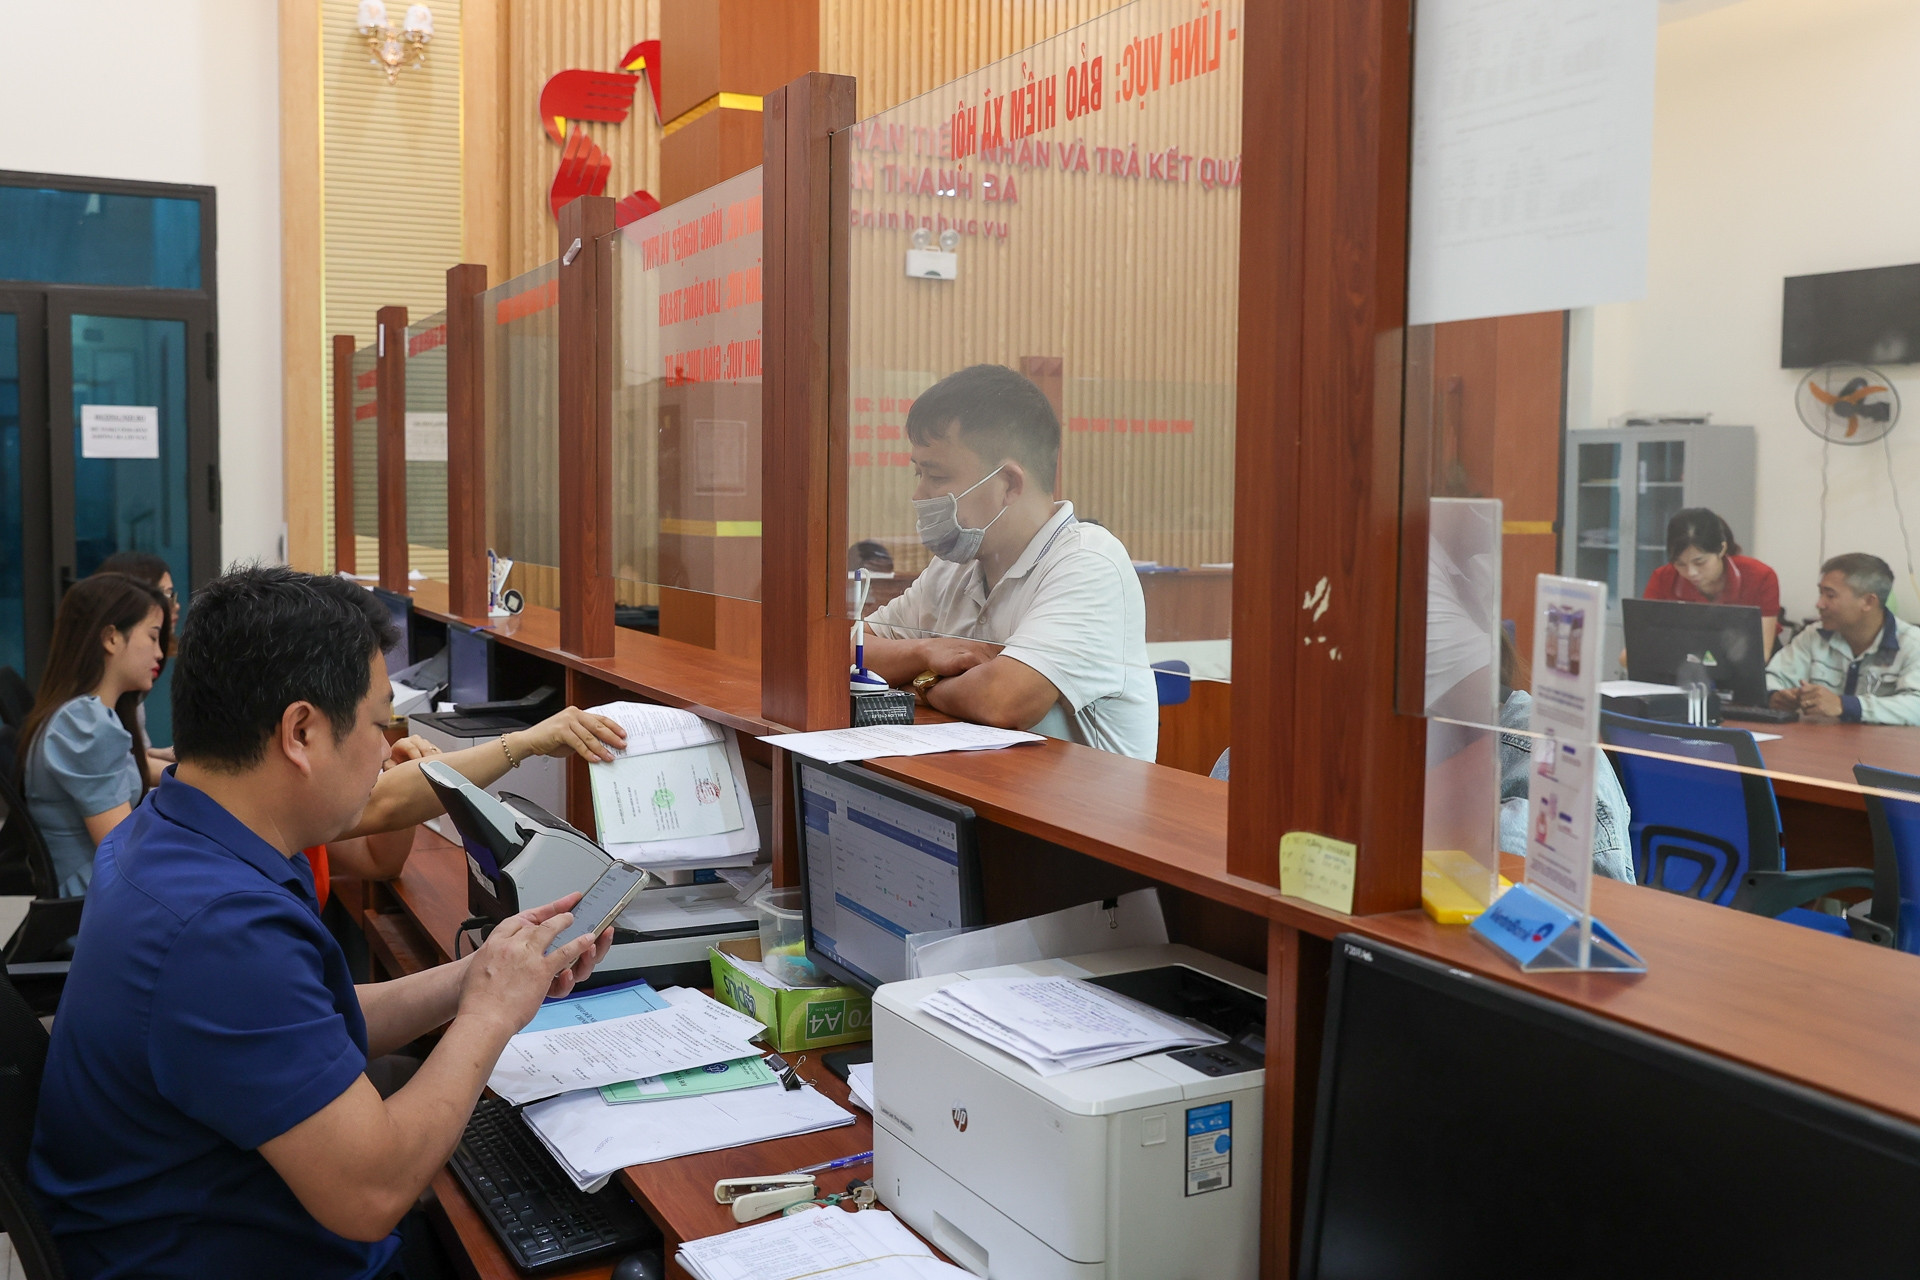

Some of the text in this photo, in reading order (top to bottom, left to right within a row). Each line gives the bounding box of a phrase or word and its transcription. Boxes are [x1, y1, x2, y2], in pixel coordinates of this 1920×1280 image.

[914, 118, 956, 158] TIẾ
[1058, 137, 1090, 174] VÀ
[1096, 142, 1141, 178] TRẢ
[1146, 145, 1193, 182] KẾT
[882, 164, 973, 200] THANH
[983, 173, 1018, 204] BA
[809, 1011, 843, 1034] A4
